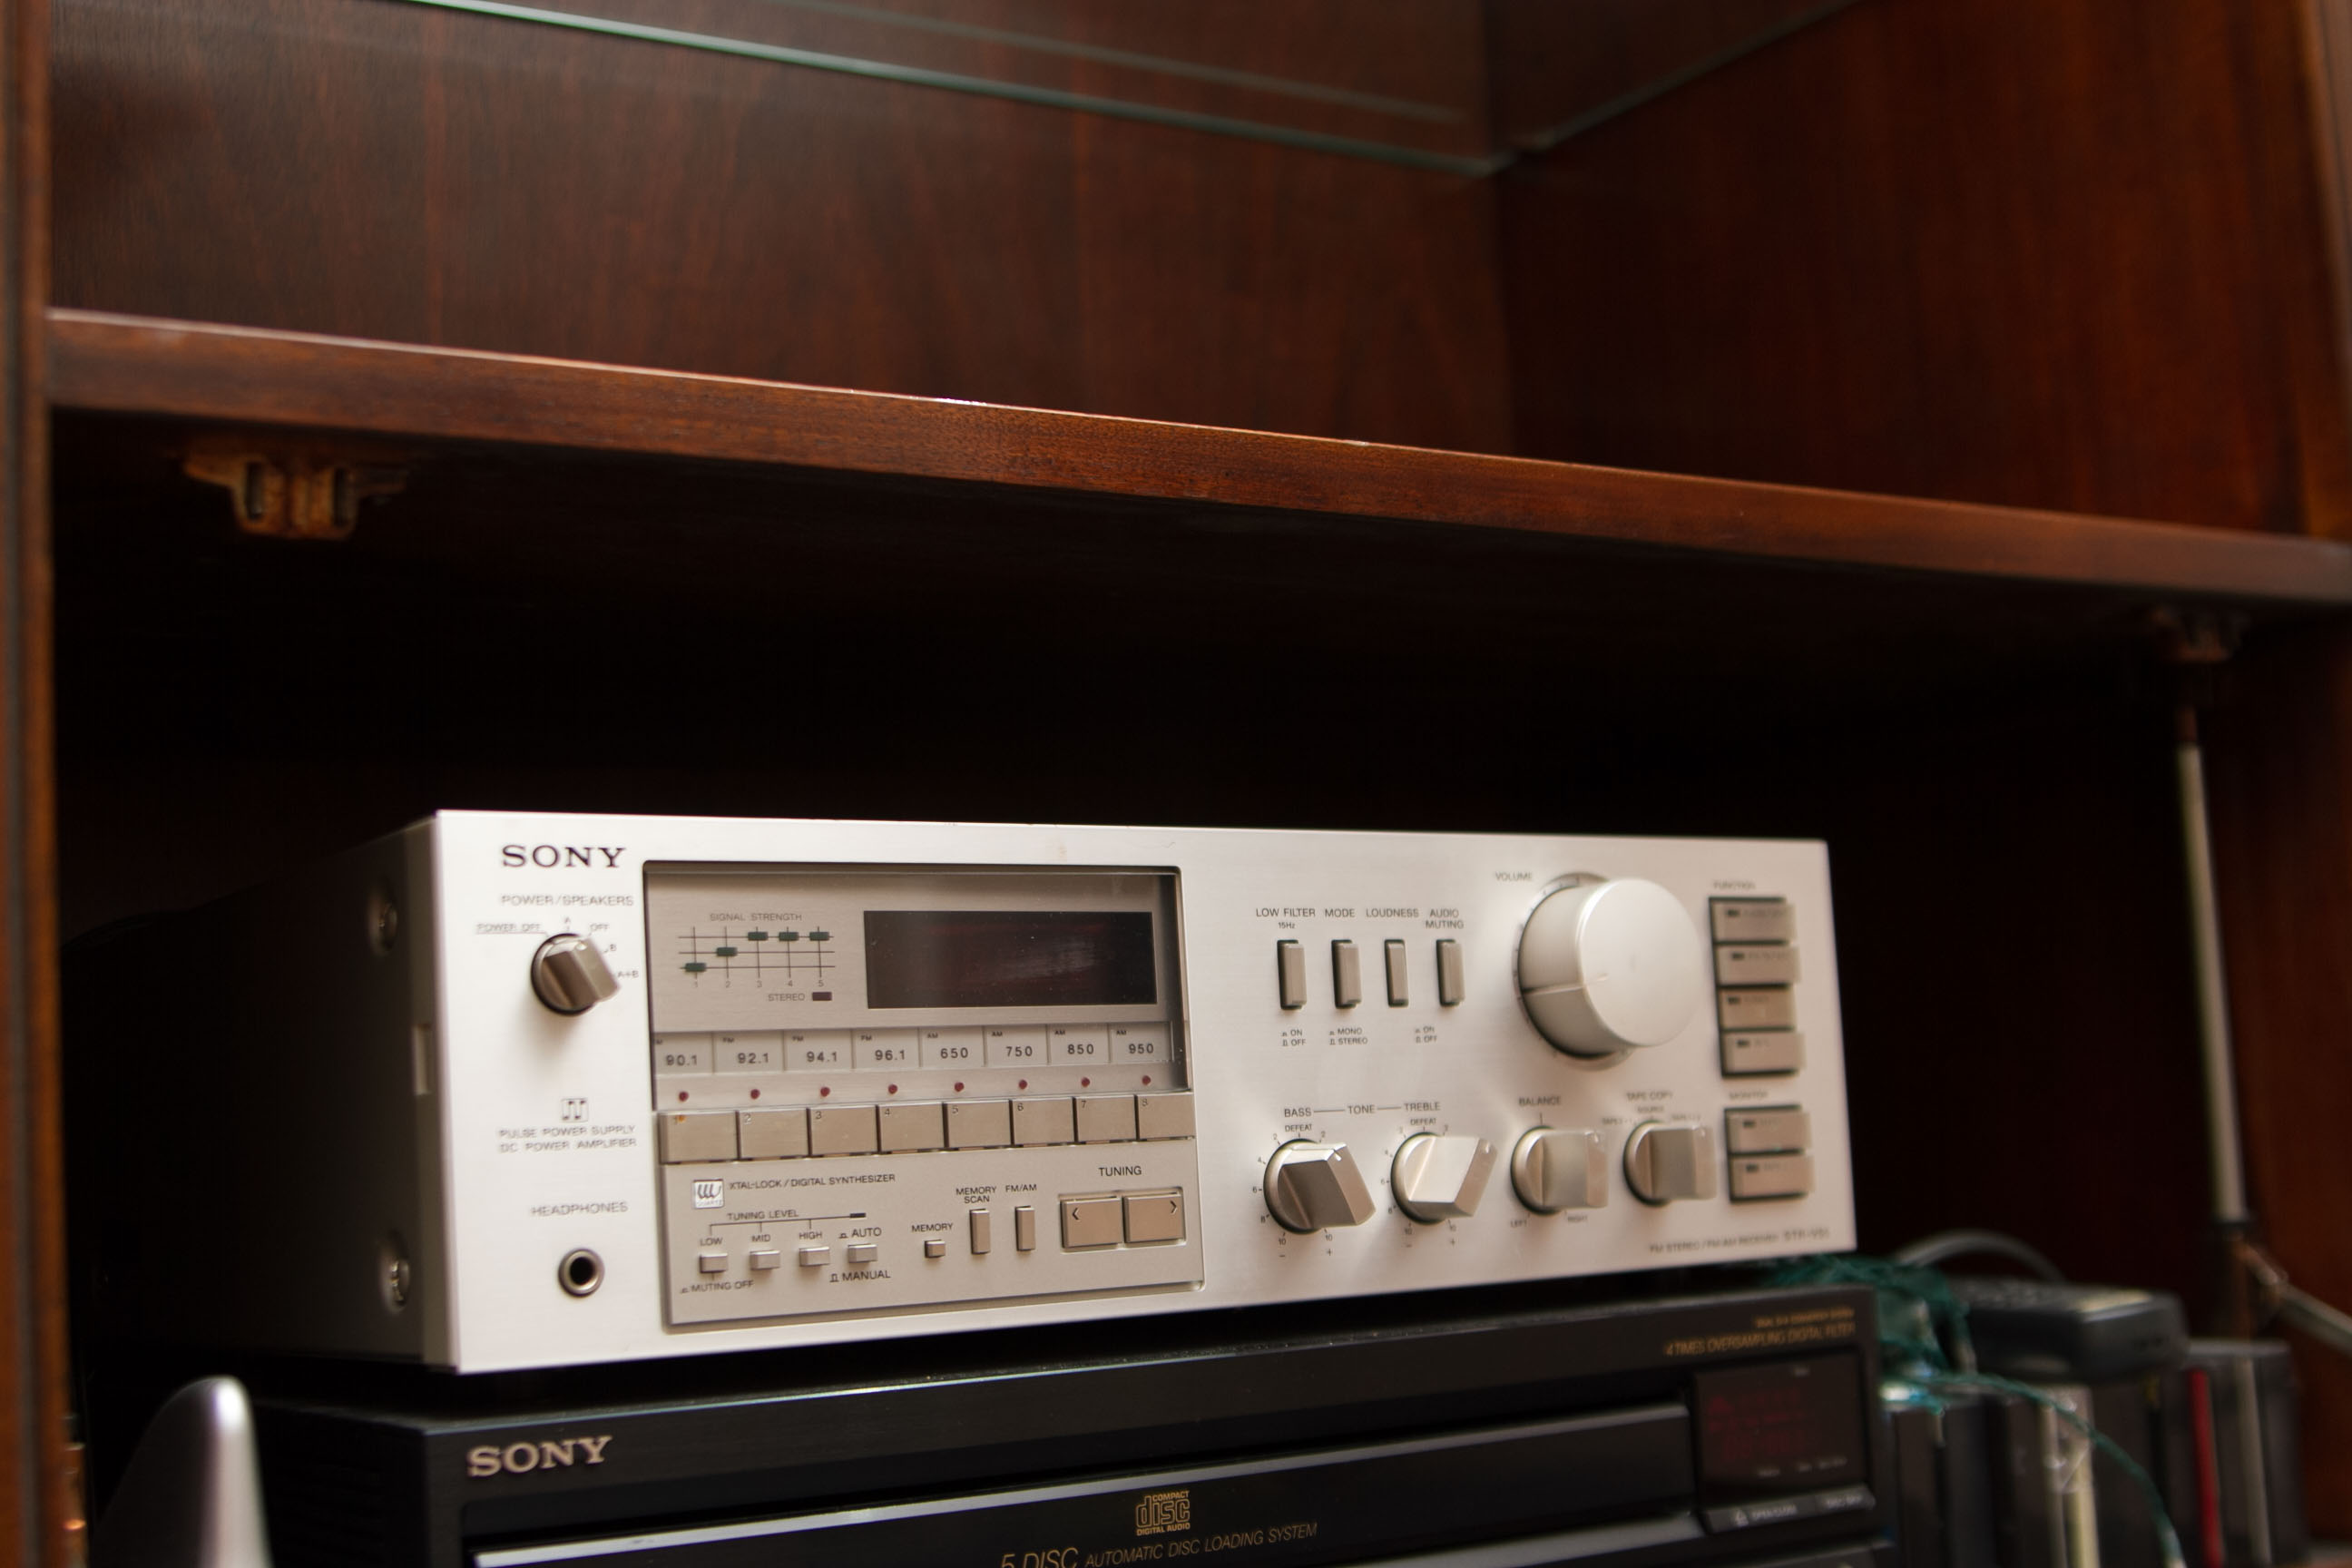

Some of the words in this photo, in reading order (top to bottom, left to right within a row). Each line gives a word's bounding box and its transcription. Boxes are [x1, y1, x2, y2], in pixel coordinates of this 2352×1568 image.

[502, 845, 626, 867] SONY
[1495, 872, 1533, 881] VOLUME
[710, 913, 746, 922] SIGNAL
[751, 913, 802, 922] STRENGTH
[1256, 908, 1279, 917] LOW
[1284, 908, 1316, 917] FILTER
[1325, 908, 1355, 917] MODE
[1366, 908, 1419, 917] LOUDNESS
[1429, 908, 1459, 917] AUDIO
[477, 923, 516, 932] POWER
[522, 923, 541, 932] OFF
[590, 923, 610, 932] OFF
[1426, 920, 1464, 929] MUTING
[757, 980, 763, 988] 3
[818, 979, 825, 987] 5
[769, 993, 806, 1002] STEREO
[1338, 1037, 1367, 1045] STEREO
[940, 1047, 969, 1059] 650
[1005, 1046, 1033, 1057] 750
[1067, 1044, 1094, 1054] 850
[1129, 1044, 1154, 1054] 950
[666, 1054, 698, 1066] 90.1
[738, 1053, 769, 1063] 92.1
[807, 1052, 838, 1063] 94.1
[875, 1050, 906, 1061] 96.1
[1081, 1100, 1087, 1108] 7
[1519, 1096, 1561, 1106] BALANCE
[884, 1108, 890, 1116] 4
[1017, 1102, 1024, 1112] 6
[1284, 1108, 1312, 1118] BASS
[1348, 1104, 1376, 1114] TONE
[1404, 1102, 1441, 1112] TREBLE
[744, 1113, 752, 1124] 2
[815, 1112, 822, 1120] 3
[1410, 1118, 1436, 1126] DEFEAT
[543, 1126, 587, 1136] POWER
[592, 1125, 636, 1135] SUPPLY
[1285, 1124, 1312, 1132] DEFEAT
[500, 1142, 518, 1152] DC
[525, 1141, 570, 1152] POWER
[577, 1138, 636, 1149] AMPLIFIER
[1098, 1166, 1142, 1177] TUNING
[829, 1173, 896, 1185] SYNTHESIZER
[956, 1186, 997, 1195] MEMORY
[1005, 1184, 1037, 1192] FM/AM
[964, 1195, 990, 1204] SCAN
[531, 1201, 629, 1216] HEADPHONES
[727, 1211, 765, 1220] TUNING
[769, 1210, 799, 1218] LEVEL
[911, 1223, 953, 1232] MEMORY
[752, 1234, 770, 1242] MID
[799, 1231, 823, 1240] HIGH
[851, 1228, 882, 1238] AUTO
[700, 1237, 722, 1246] LOW
[842, 1270, 890, 1280] MANUAL
[691, 1281, 732, 1292] MUTING
[734, 1280, 754, 1289] OFF
[467, 1436, 612, 1477] SONY
[1152, 1491, 1190, 1502] COMPACT
[1135, 1495, 1191, 1528] disc
[1136, 1526, 1165, 1536] DIGITAL
[1167, 1523, 1191, 1532] AUDIO
[1023, 1546, 1079, 1568] DISC
[1084, 1544, 1163, 1568] AUTOMATIC
[1169, 1540, 1200, 1556] DISC
[1205, 1531, 1264, 1553] LOADING
[1269, 1523, 1318, 1543] SYSTEM
